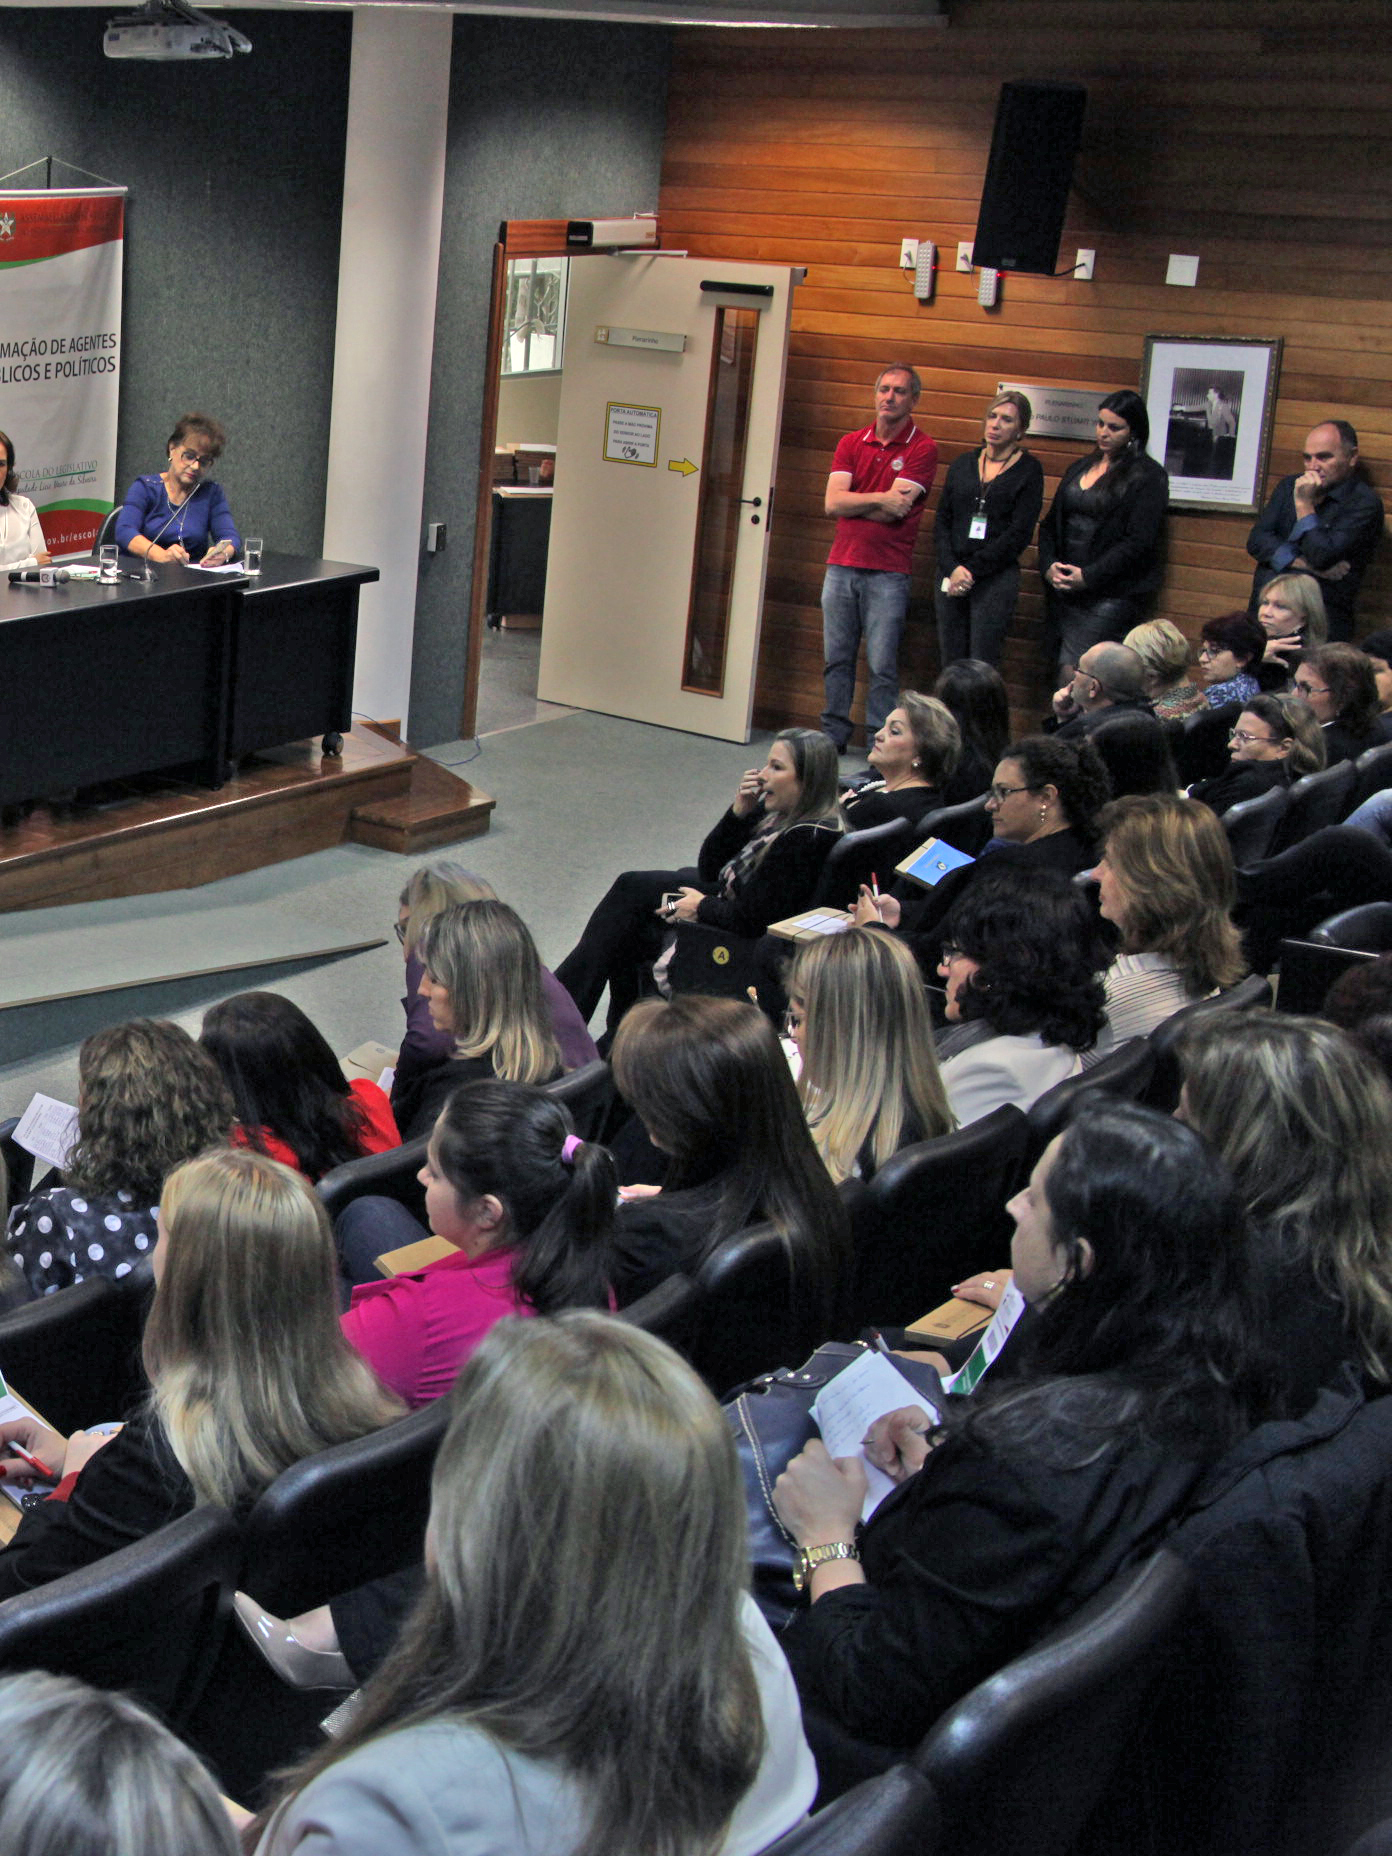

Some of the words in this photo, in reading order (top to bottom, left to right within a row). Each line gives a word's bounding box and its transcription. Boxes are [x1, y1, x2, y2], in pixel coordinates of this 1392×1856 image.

[50, 338, 66, 355] DE
[68, 333, 117, 353] AGENTES
[44, 363, 52, 380] E
[55, 356, 116, 379] POLÍTICOS
[15, 468, 41, 481] SCOLA
[47, 528, 100, 546] ov.br/escol
[718, 951, 726, 961] A
